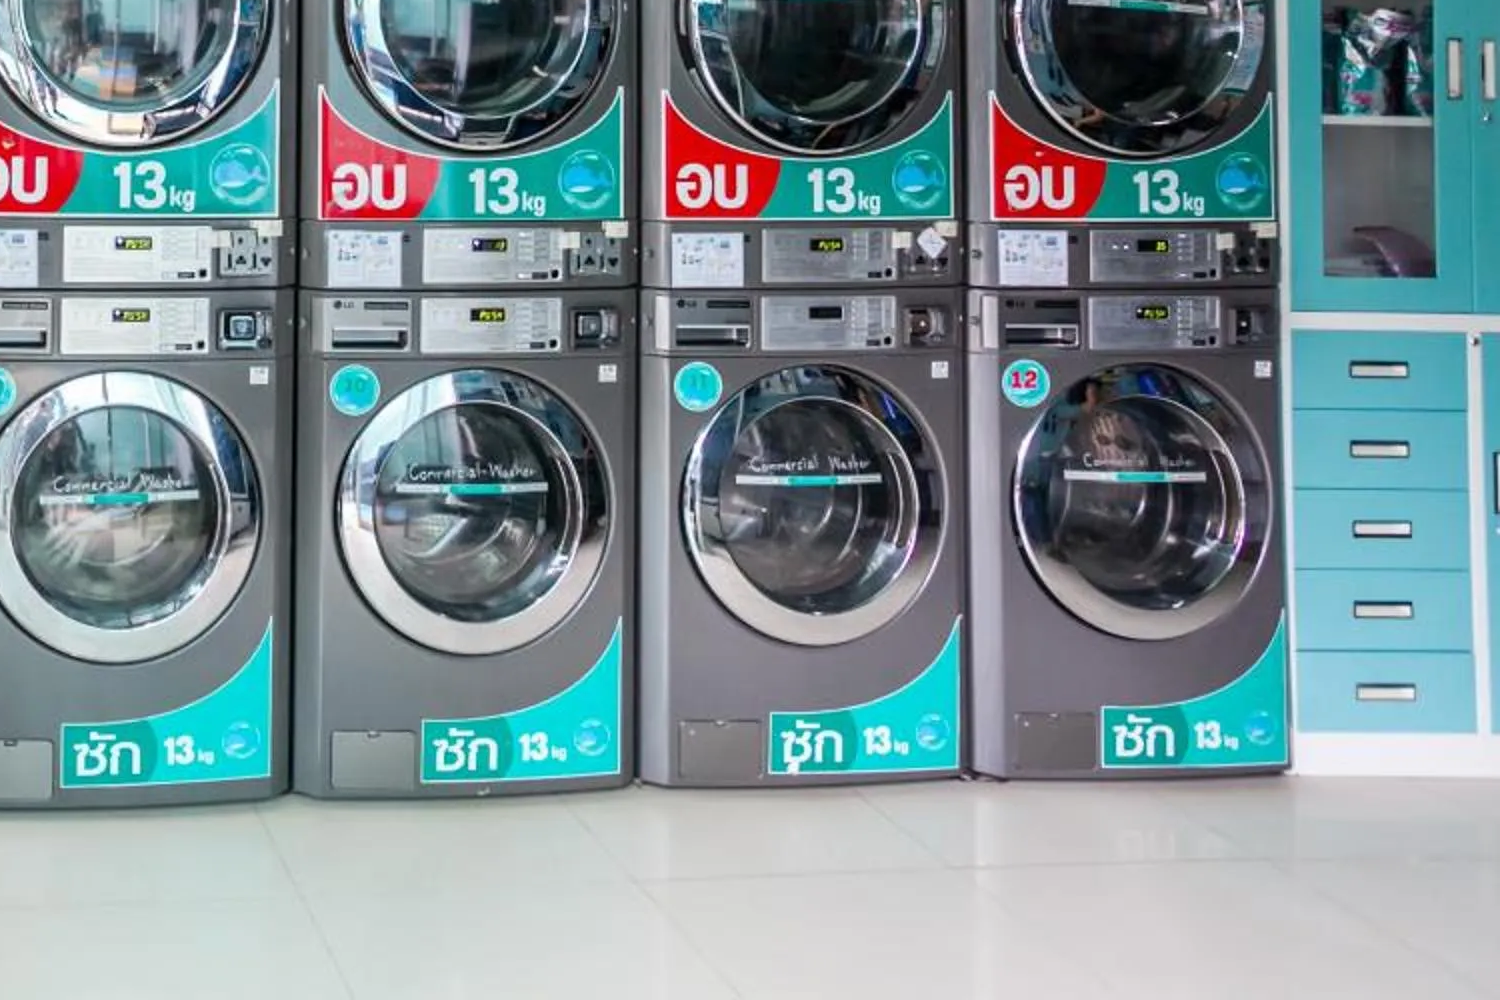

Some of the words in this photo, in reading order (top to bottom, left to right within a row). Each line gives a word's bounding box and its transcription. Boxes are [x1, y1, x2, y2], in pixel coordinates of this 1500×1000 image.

[113, 160, 168, 209] 13
[170, 185, 196, 213] kg
[331, 162, 408, 211] อบ
[468, 167, 520, 215] 13
[521, 191, 546, 217] kg
[675, 163, 749, 210] อบ
[807, 167, 856, 214] 13
[858, 191, 881, 216] kg
[1003, 165, 1075, 211] อบ
[1133, 169, 1180, 215] 13
[1182, 191, 1205, 217] kg
[1011, 370, 1038, 389] 12
[750, 454, 820, 473] Commercial
[53, 474, 131, 493] Commercial
[163, 734, 196, 766] 13
[518, 731, 550, 762] 13
[862, 725, 893, 756] 13
[1193, 720, 1223, 750] 13
